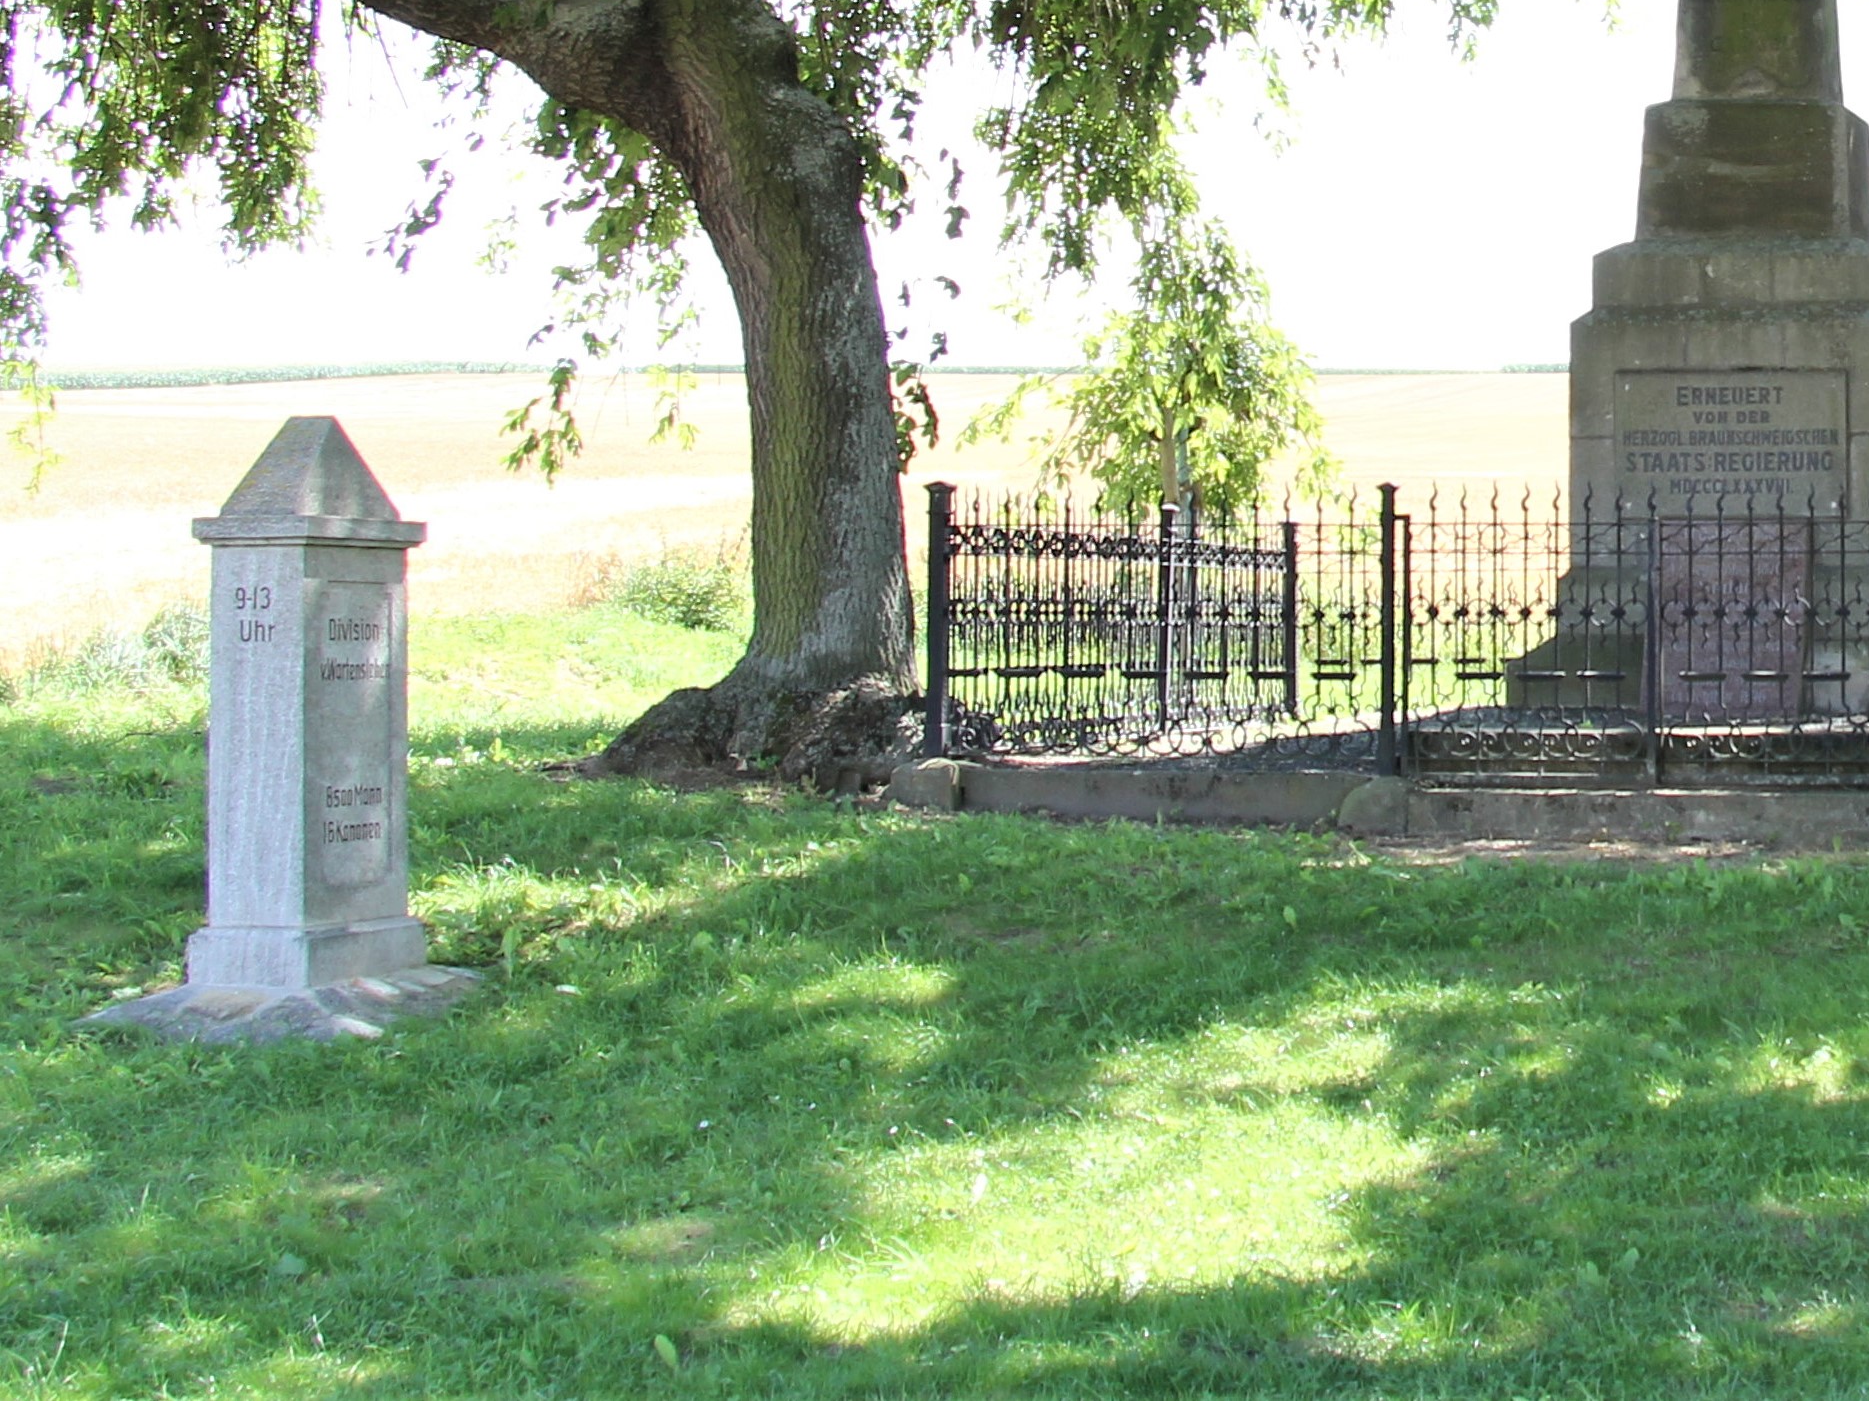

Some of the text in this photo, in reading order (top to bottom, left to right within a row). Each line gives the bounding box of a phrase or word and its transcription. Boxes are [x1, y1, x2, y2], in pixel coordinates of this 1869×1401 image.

[1676, 386, 1784, 406] ERNEUERT
[1692, 411, 1770, 424] VON DER
[1689, 429, 1839, 447] BRAUNSCHWEIGSCHEN
[235, 587, 271, 610] 9-13
[239, 620, 275, 642] Uhr
[329, 618, 380, 642] Division
[354, 783, 382, 806] Mann
[323, 819, 381, 844] 16 Kanonen
